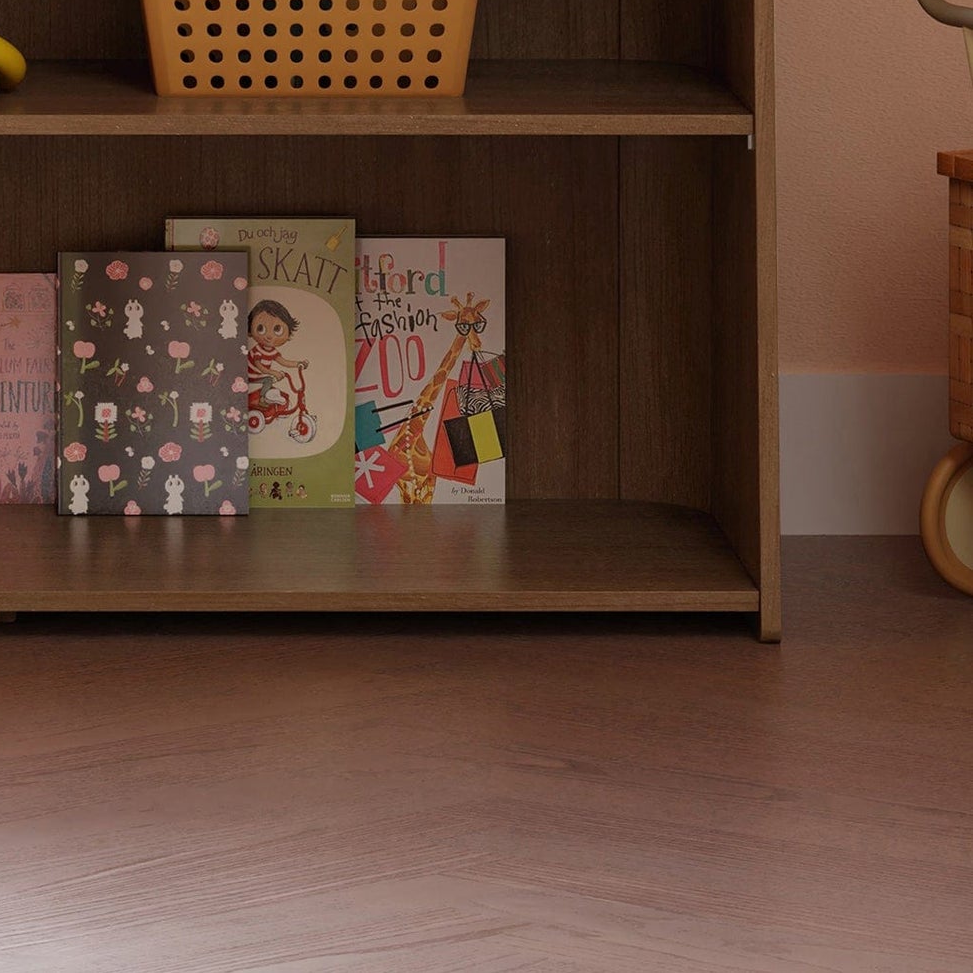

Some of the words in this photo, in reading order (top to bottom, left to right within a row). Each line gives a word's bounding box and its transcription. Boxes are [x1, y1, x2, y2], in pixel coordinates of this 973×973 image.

[238, 229, 254, 242] Du
[257, 227, 276, 239] och
[276, 228, 298, 245] jag
[257, 246, 348, 294] SKATT
[373, 293, 402, 311] the
[355, 303, 438, 347] fashion
[355, 334, 426, 398] ZOO
[468, 495, 503, 503] Robertson
